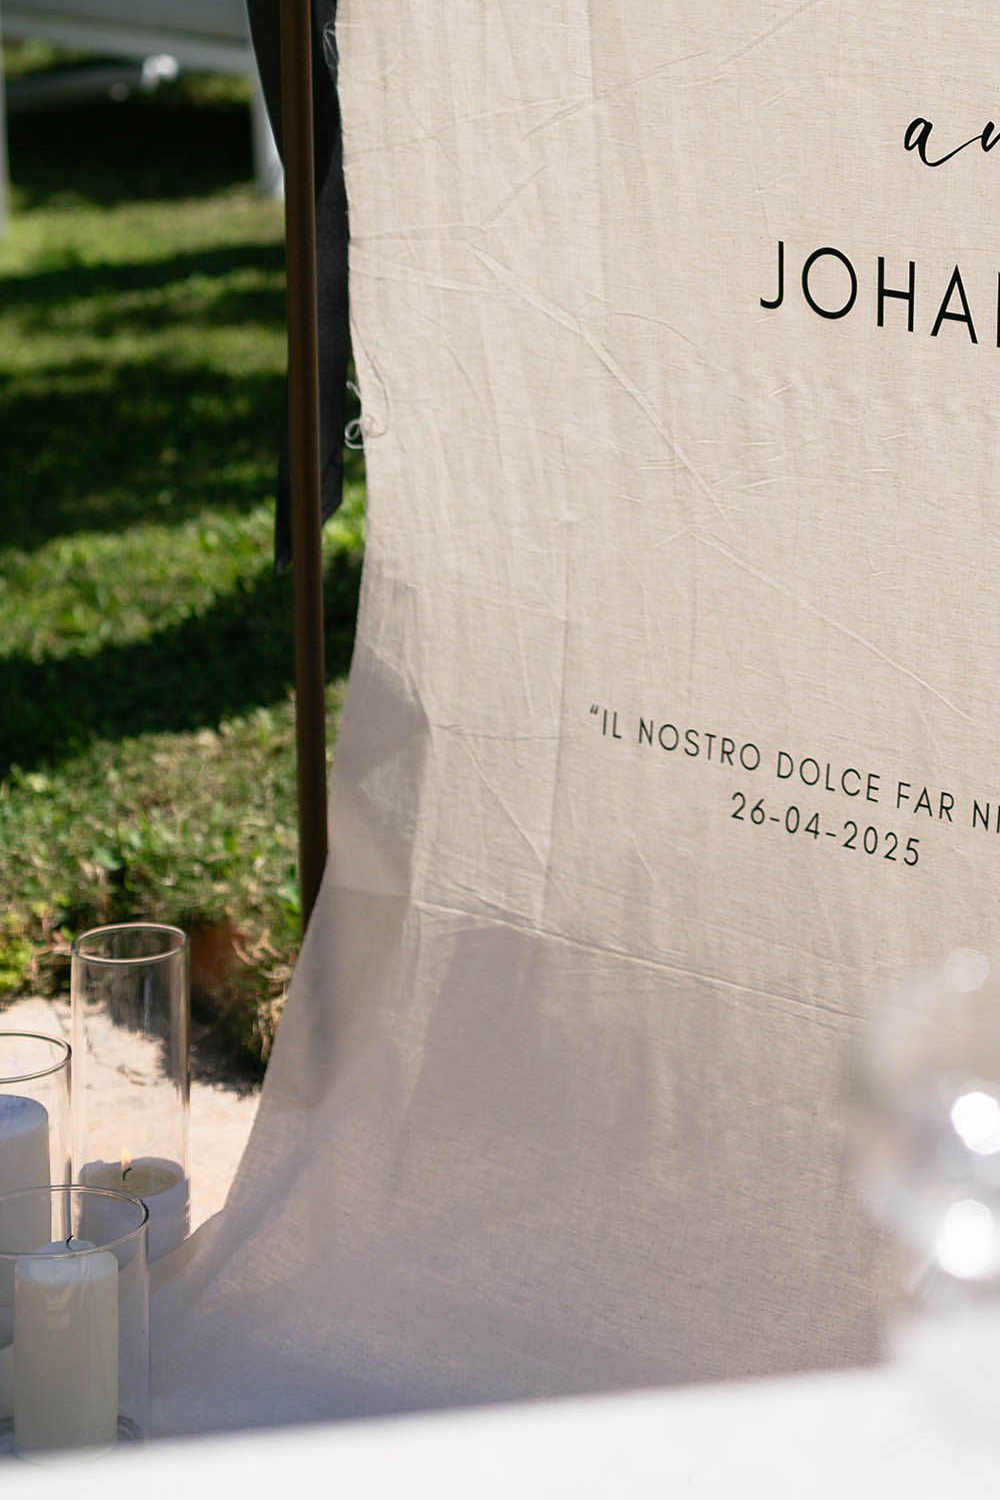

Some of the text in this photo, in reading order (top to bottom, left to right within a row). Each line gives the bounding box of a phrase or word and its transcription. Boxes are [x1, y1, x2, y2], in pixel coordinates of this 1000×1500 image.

[638, 717, 761, 771] NOSTRO
[776, 750, 881, 803] DOLCE
[896, 781, 955, 823] FAR
[730, 791, 920, 867] 26-04-2025
